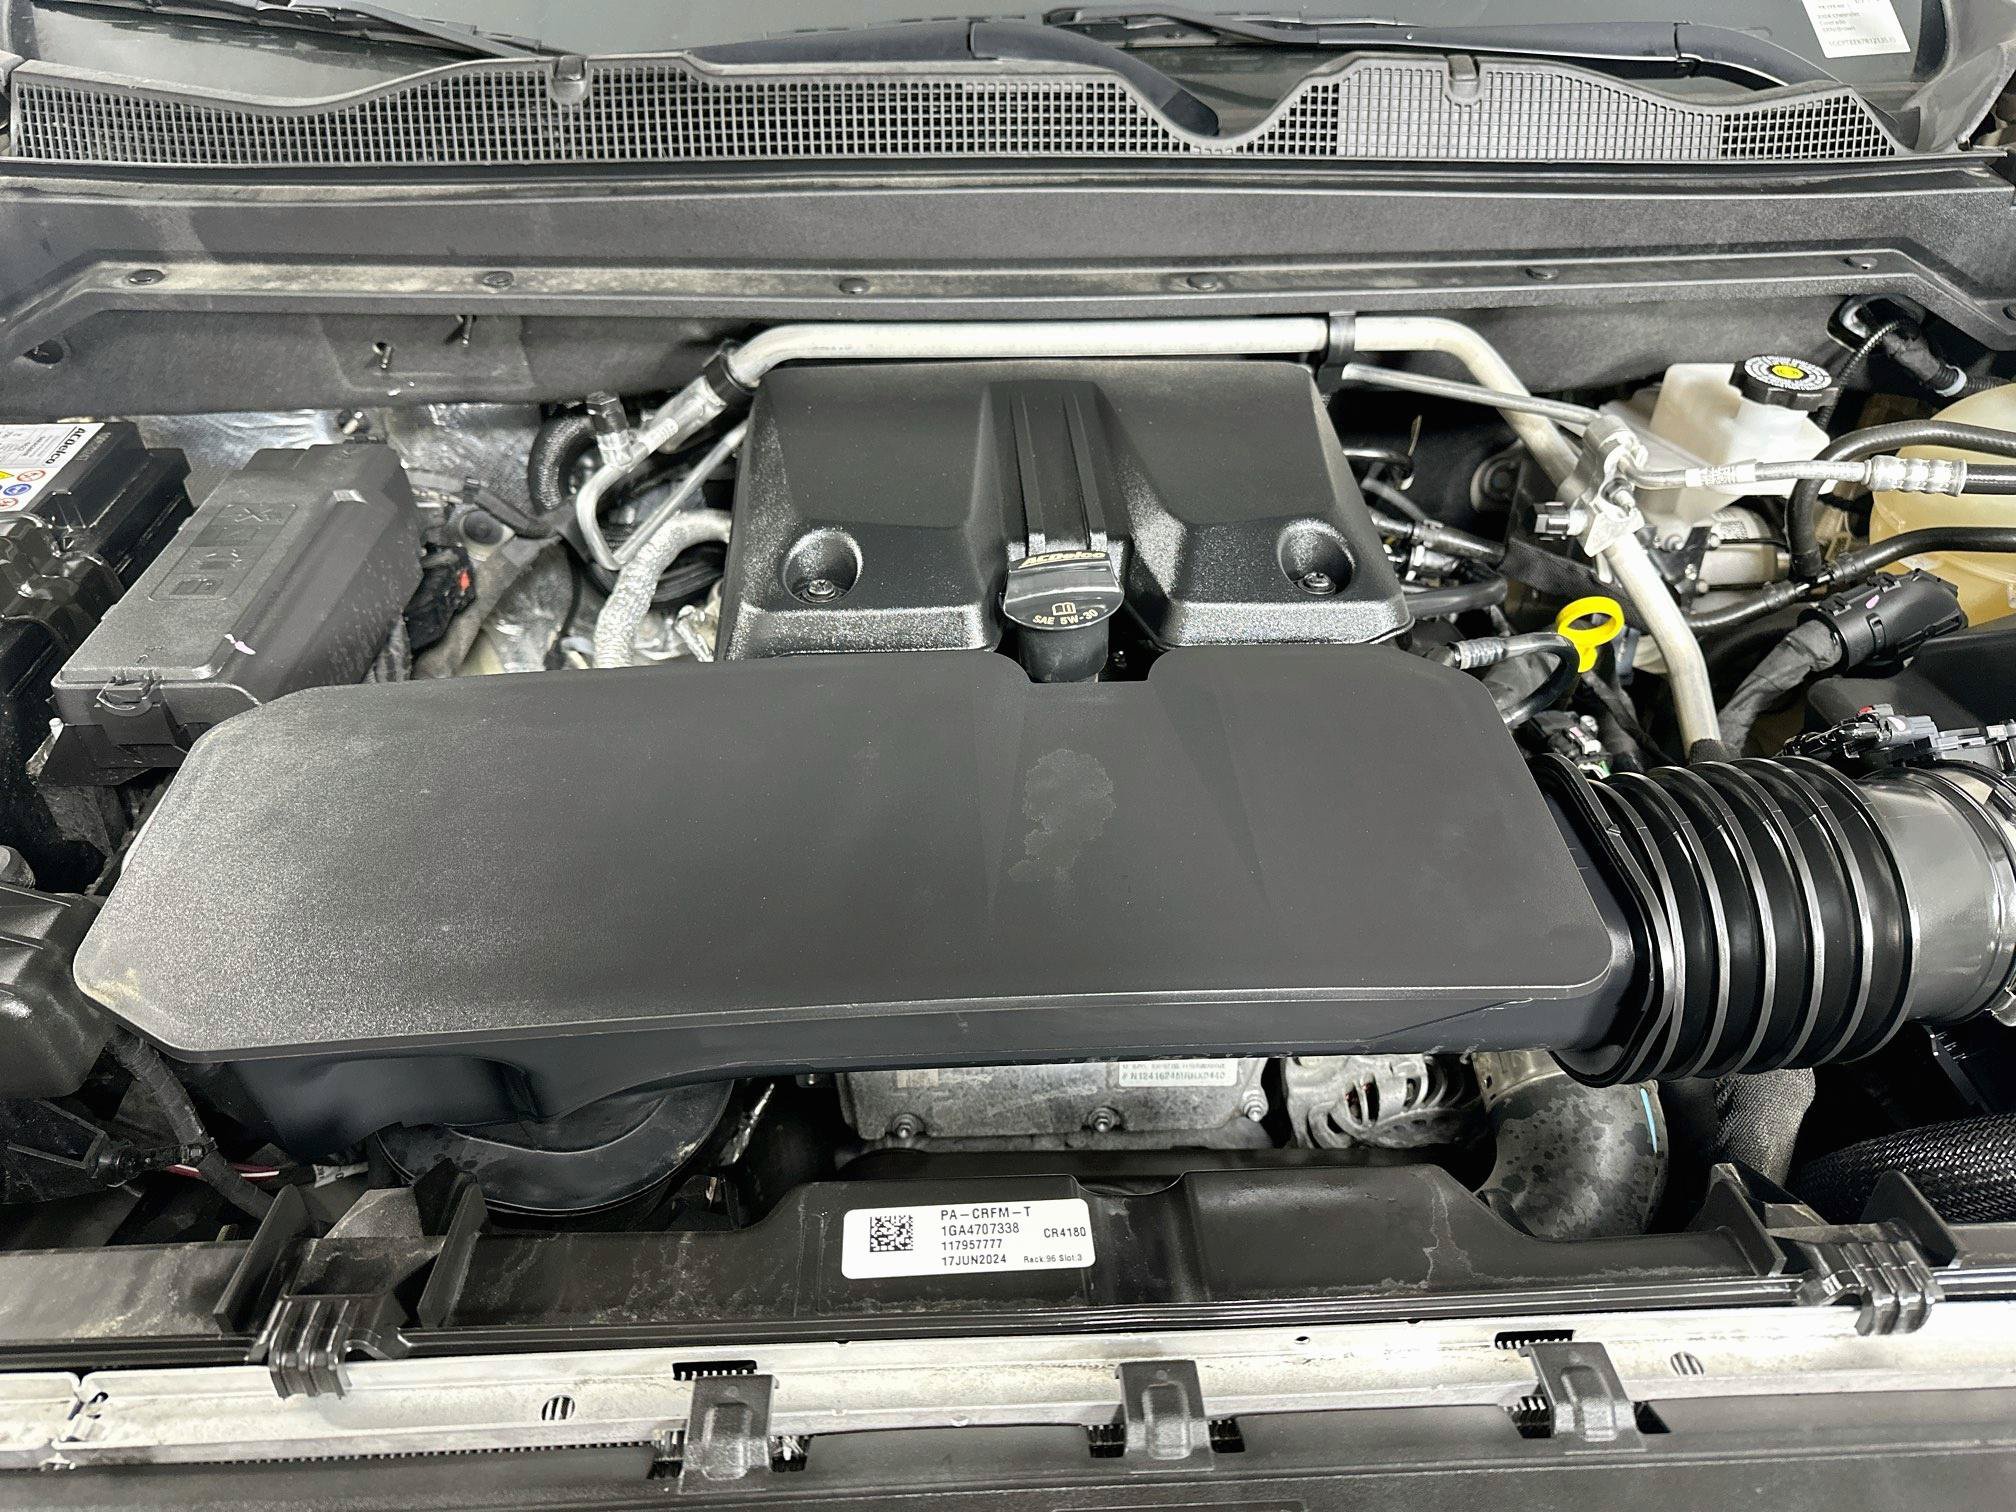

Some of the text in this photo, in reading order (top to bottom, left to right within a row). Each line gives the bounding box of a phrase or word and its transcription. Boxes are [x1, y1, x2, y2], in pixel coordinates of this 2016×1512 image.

[45, 427, 86, 465] ACDelco
[1018, 551, 1106, 569] ACDelco
[1033, 609, 1099, 625] SAE 5W-30
[941, 1222, 1020, 1236] 1GA4707338
[1043, 1226, 1087, 1239] CR4180
[941, 1238, 1003, 1251] 117957777
[941, 1254, 1008, 1266] 17JUN2024
